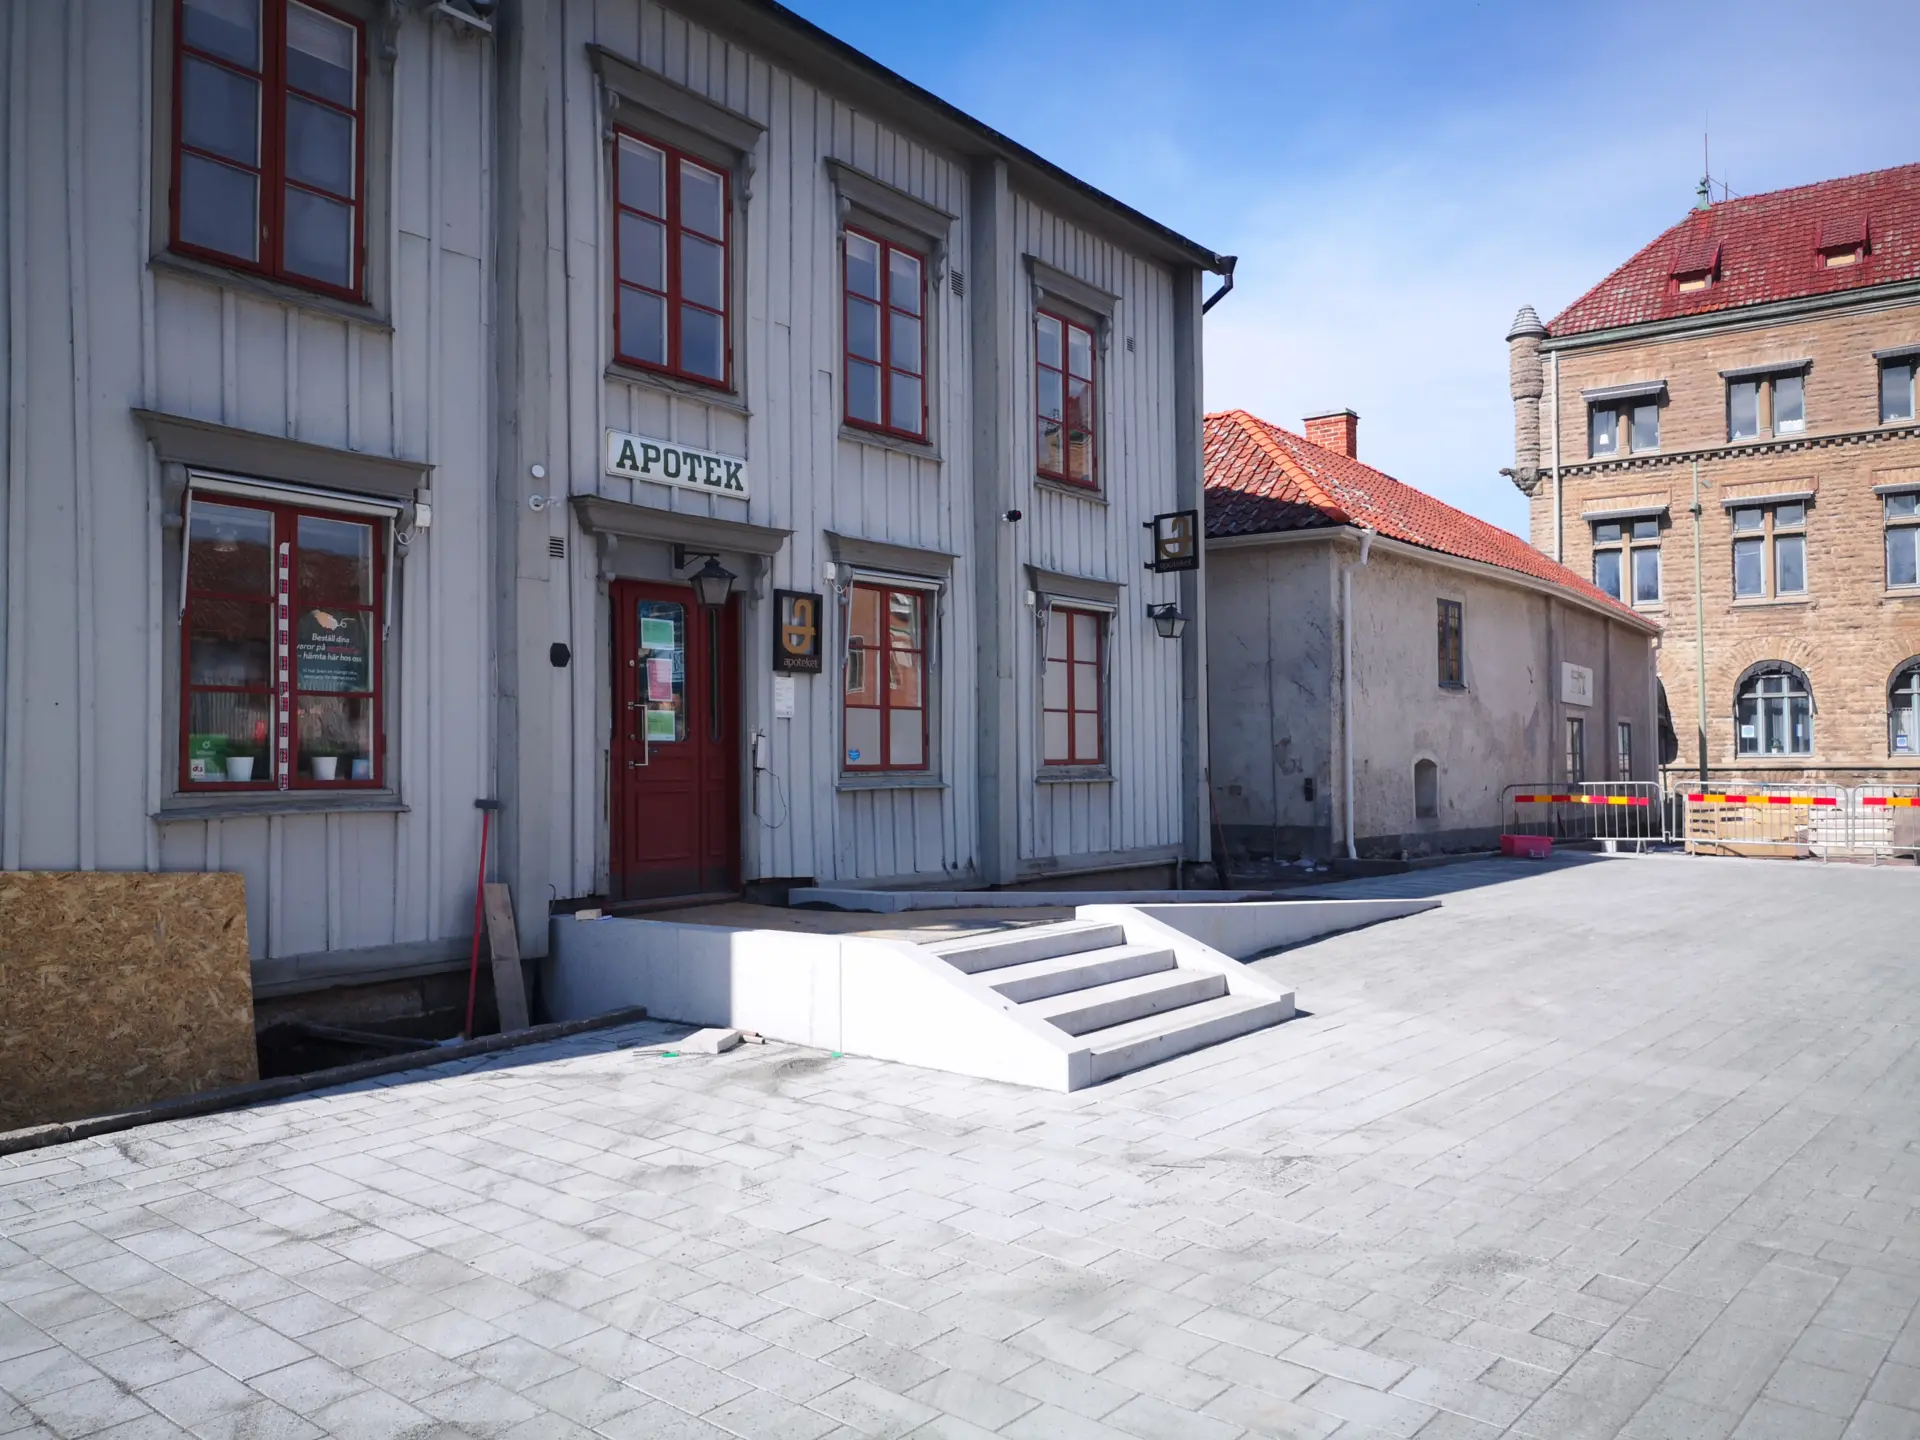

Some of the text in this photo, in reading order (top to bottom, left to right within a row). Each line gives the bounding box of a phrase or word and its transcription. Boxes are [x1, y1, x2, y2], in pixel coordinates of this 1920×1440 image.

[616, 439, 744, 491] APOTEK
[312, 633, 335, 642] Beställ
[316, 644, 326, 652] på
[303, 653, 326, 661] hämta
[327, 652, 339, 662] här
[340, 654, 351, 662] hos
[783, 657, 819, 670] apoteket
